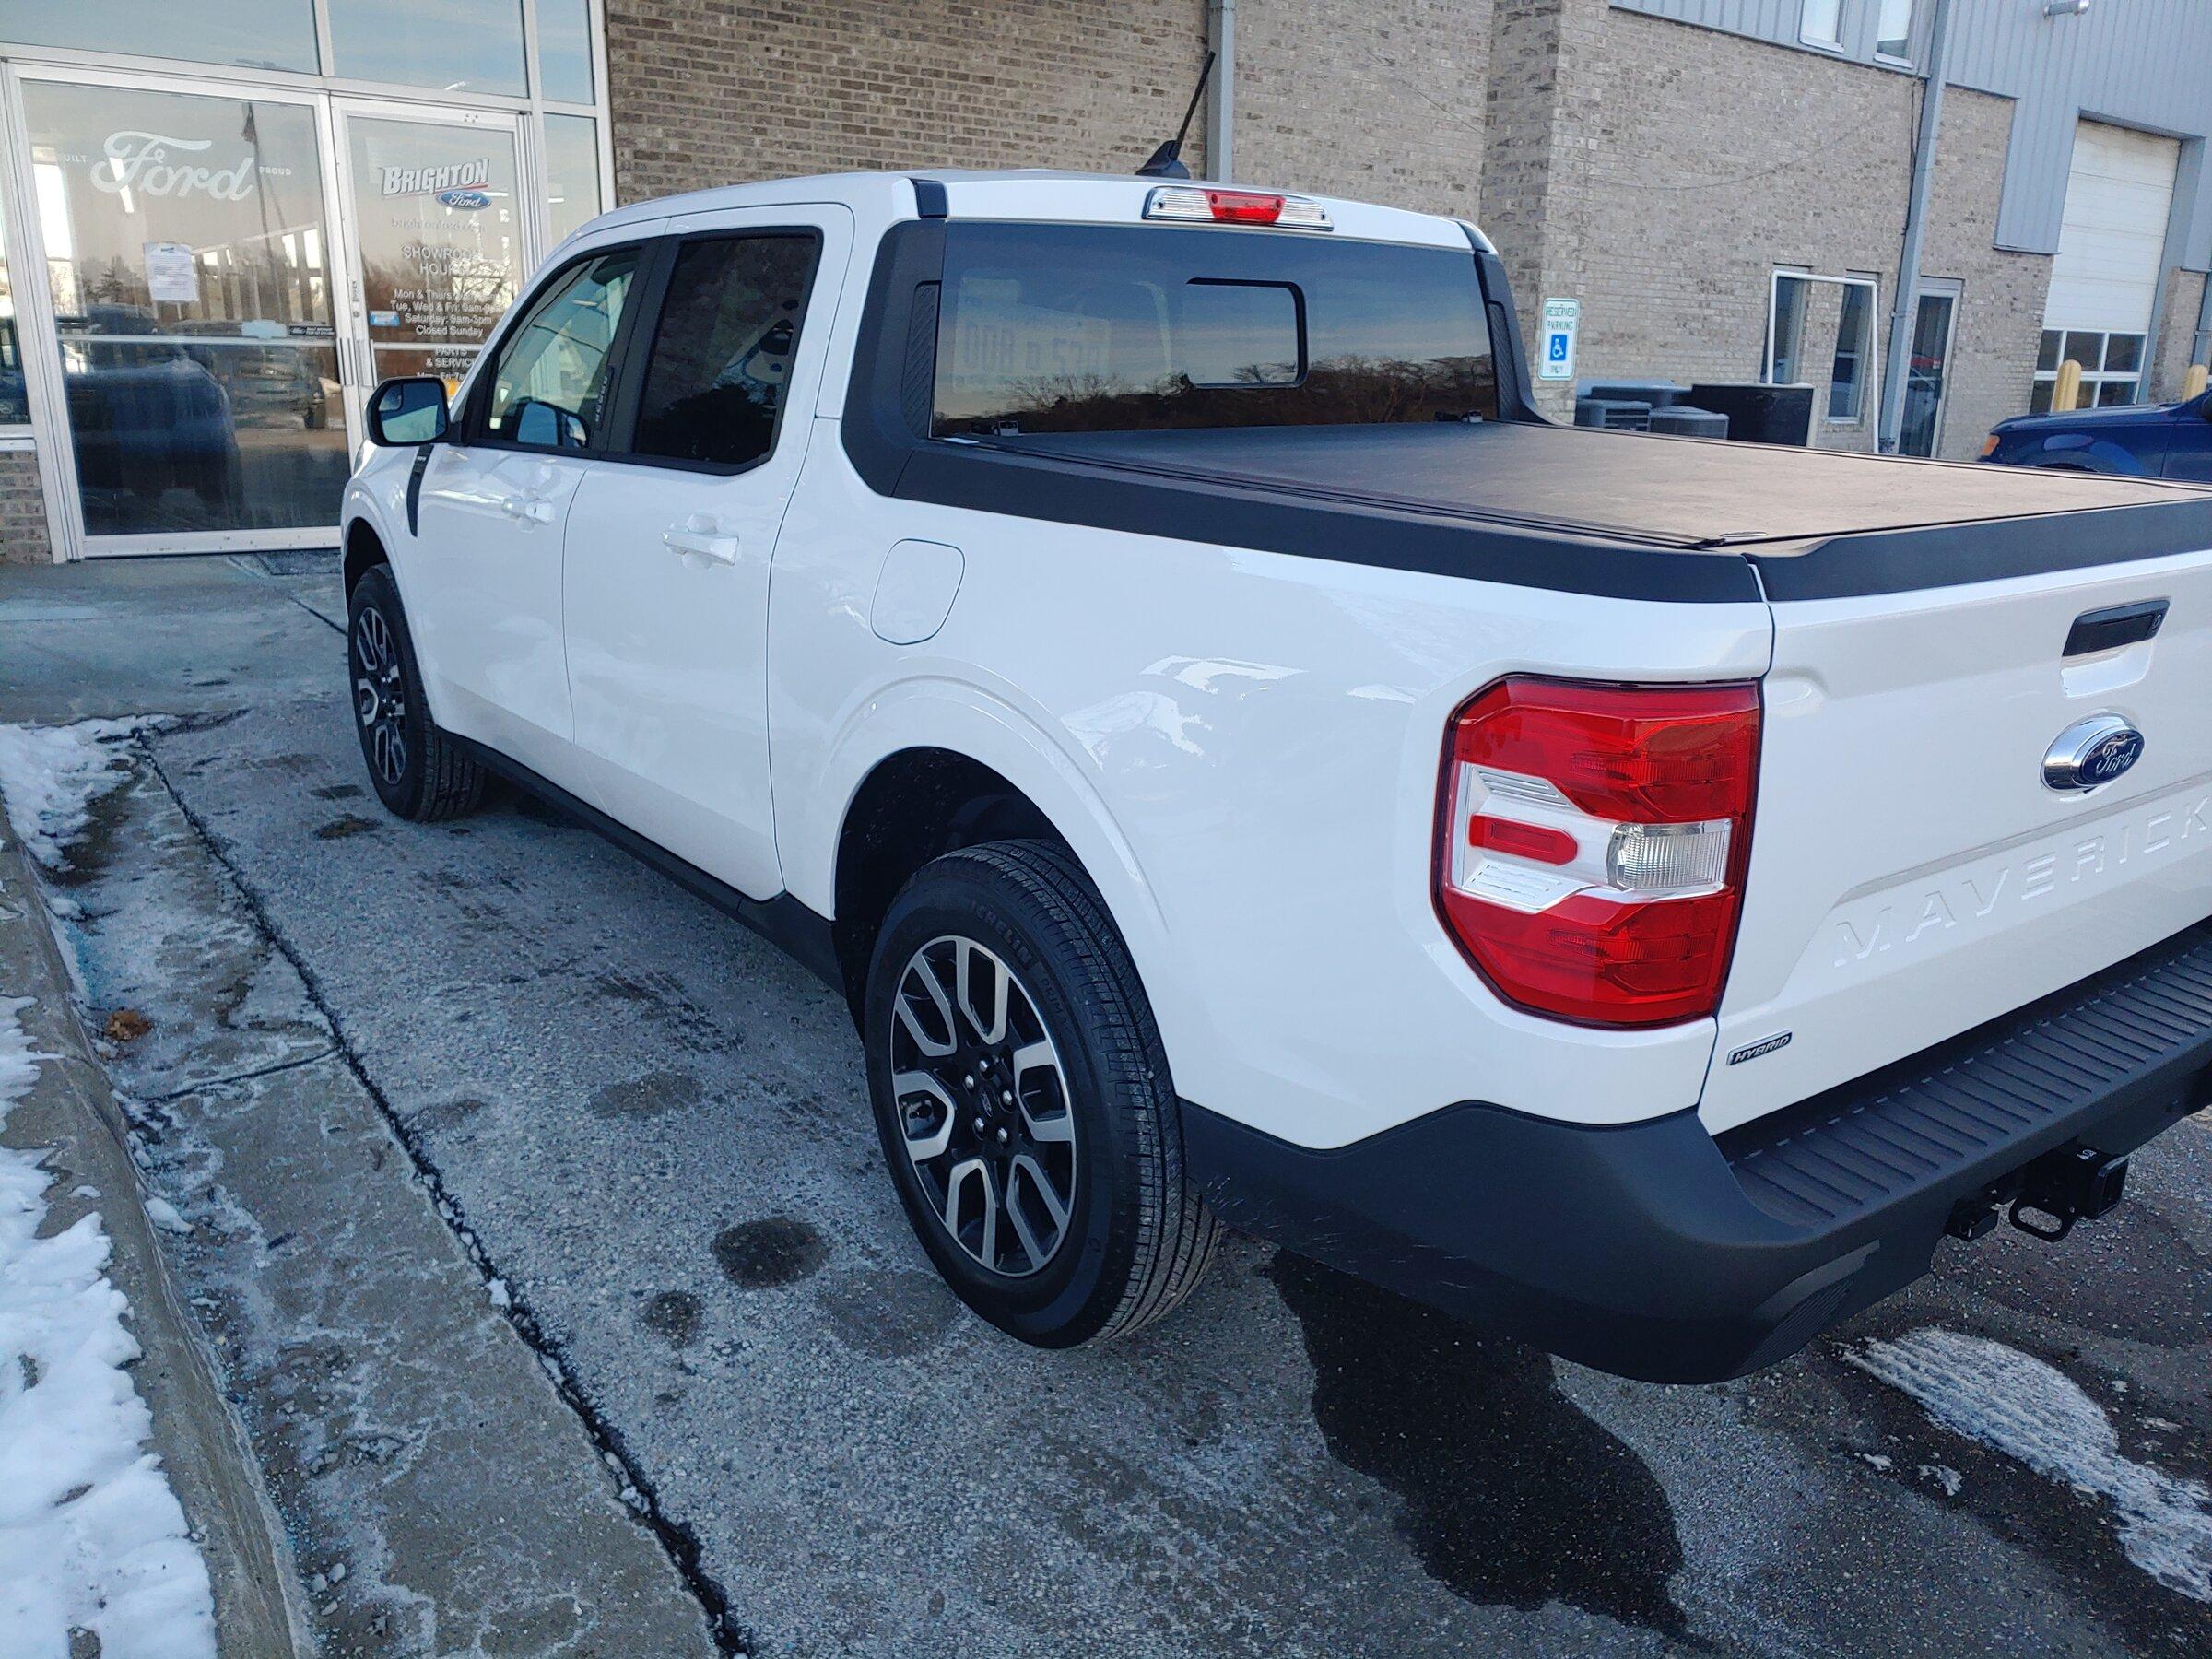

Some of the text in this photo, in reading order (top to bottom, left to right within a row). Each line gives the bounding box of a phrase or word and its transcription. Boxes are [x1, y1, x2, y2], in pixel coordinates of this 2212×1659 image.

[58, 130, 292, 200] UILT Ford PROUD
[379, 158, 489, 194] BRIGHTON
[449, 192, 482, 208] Ford
[394, 288, 415, 300] Mon
[417, 289, 425, 300] &
[412, 301, 434, 312] Wed
[436, 302, 443, 312] &
[416, 325, 484, 338] Closed Sunday
[436, 347, 468, 357] PARTS
[426, 357, 433, 368] &
[2095, 737, 2138, 775] Ford
[1833, 795, 2209, 968] MAVERICK
[1733, 1035, 1790, 1063] HYBRID
